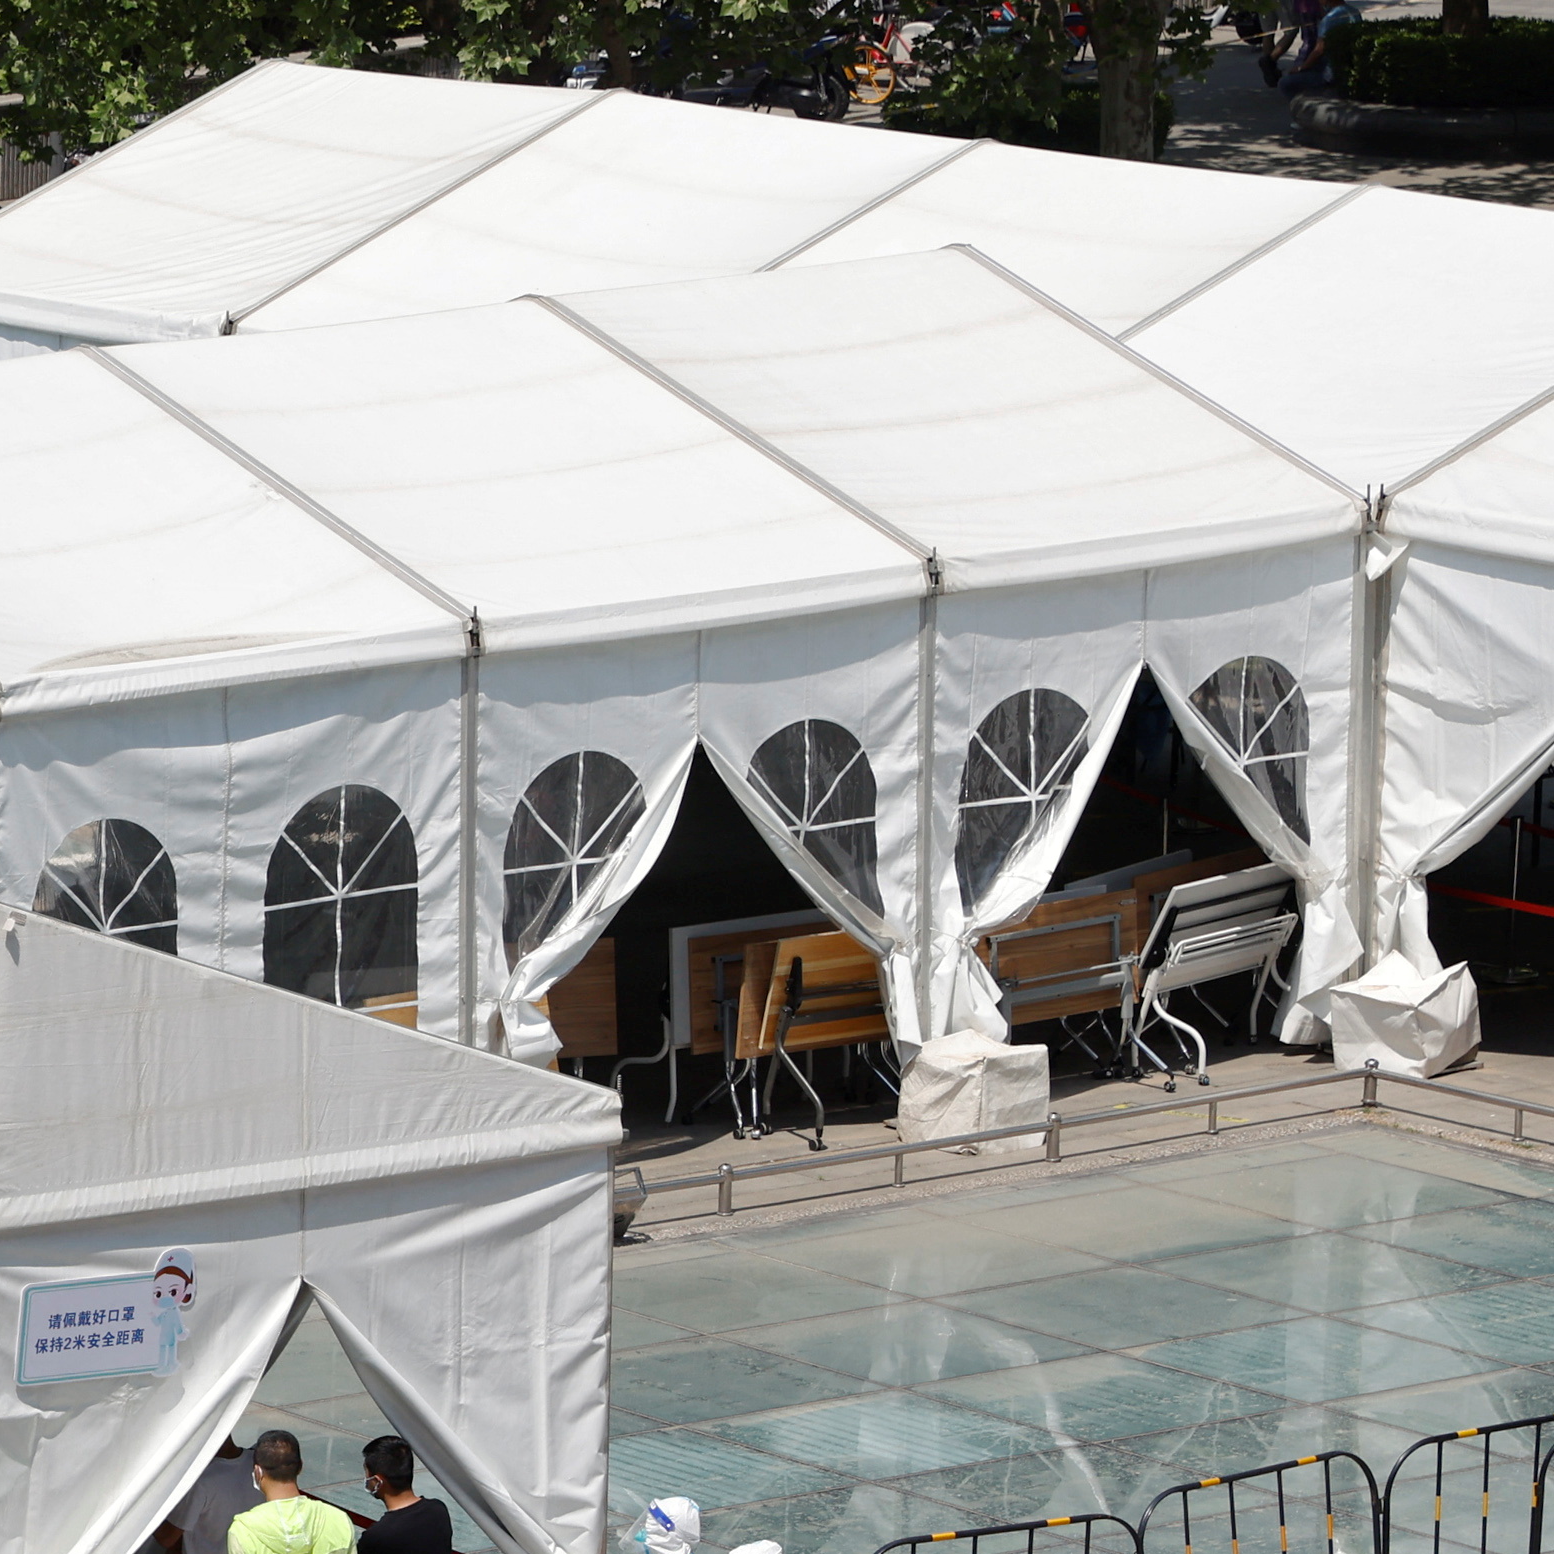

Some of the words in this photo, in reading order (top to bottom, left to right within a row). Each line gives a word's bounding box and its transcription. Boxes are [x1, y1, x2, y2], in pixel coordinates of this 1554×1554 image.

[48, 1306, 135, 1330] 请佩戴好口罩
[35, 1328, 145, 1354] 保持2米安全距离
